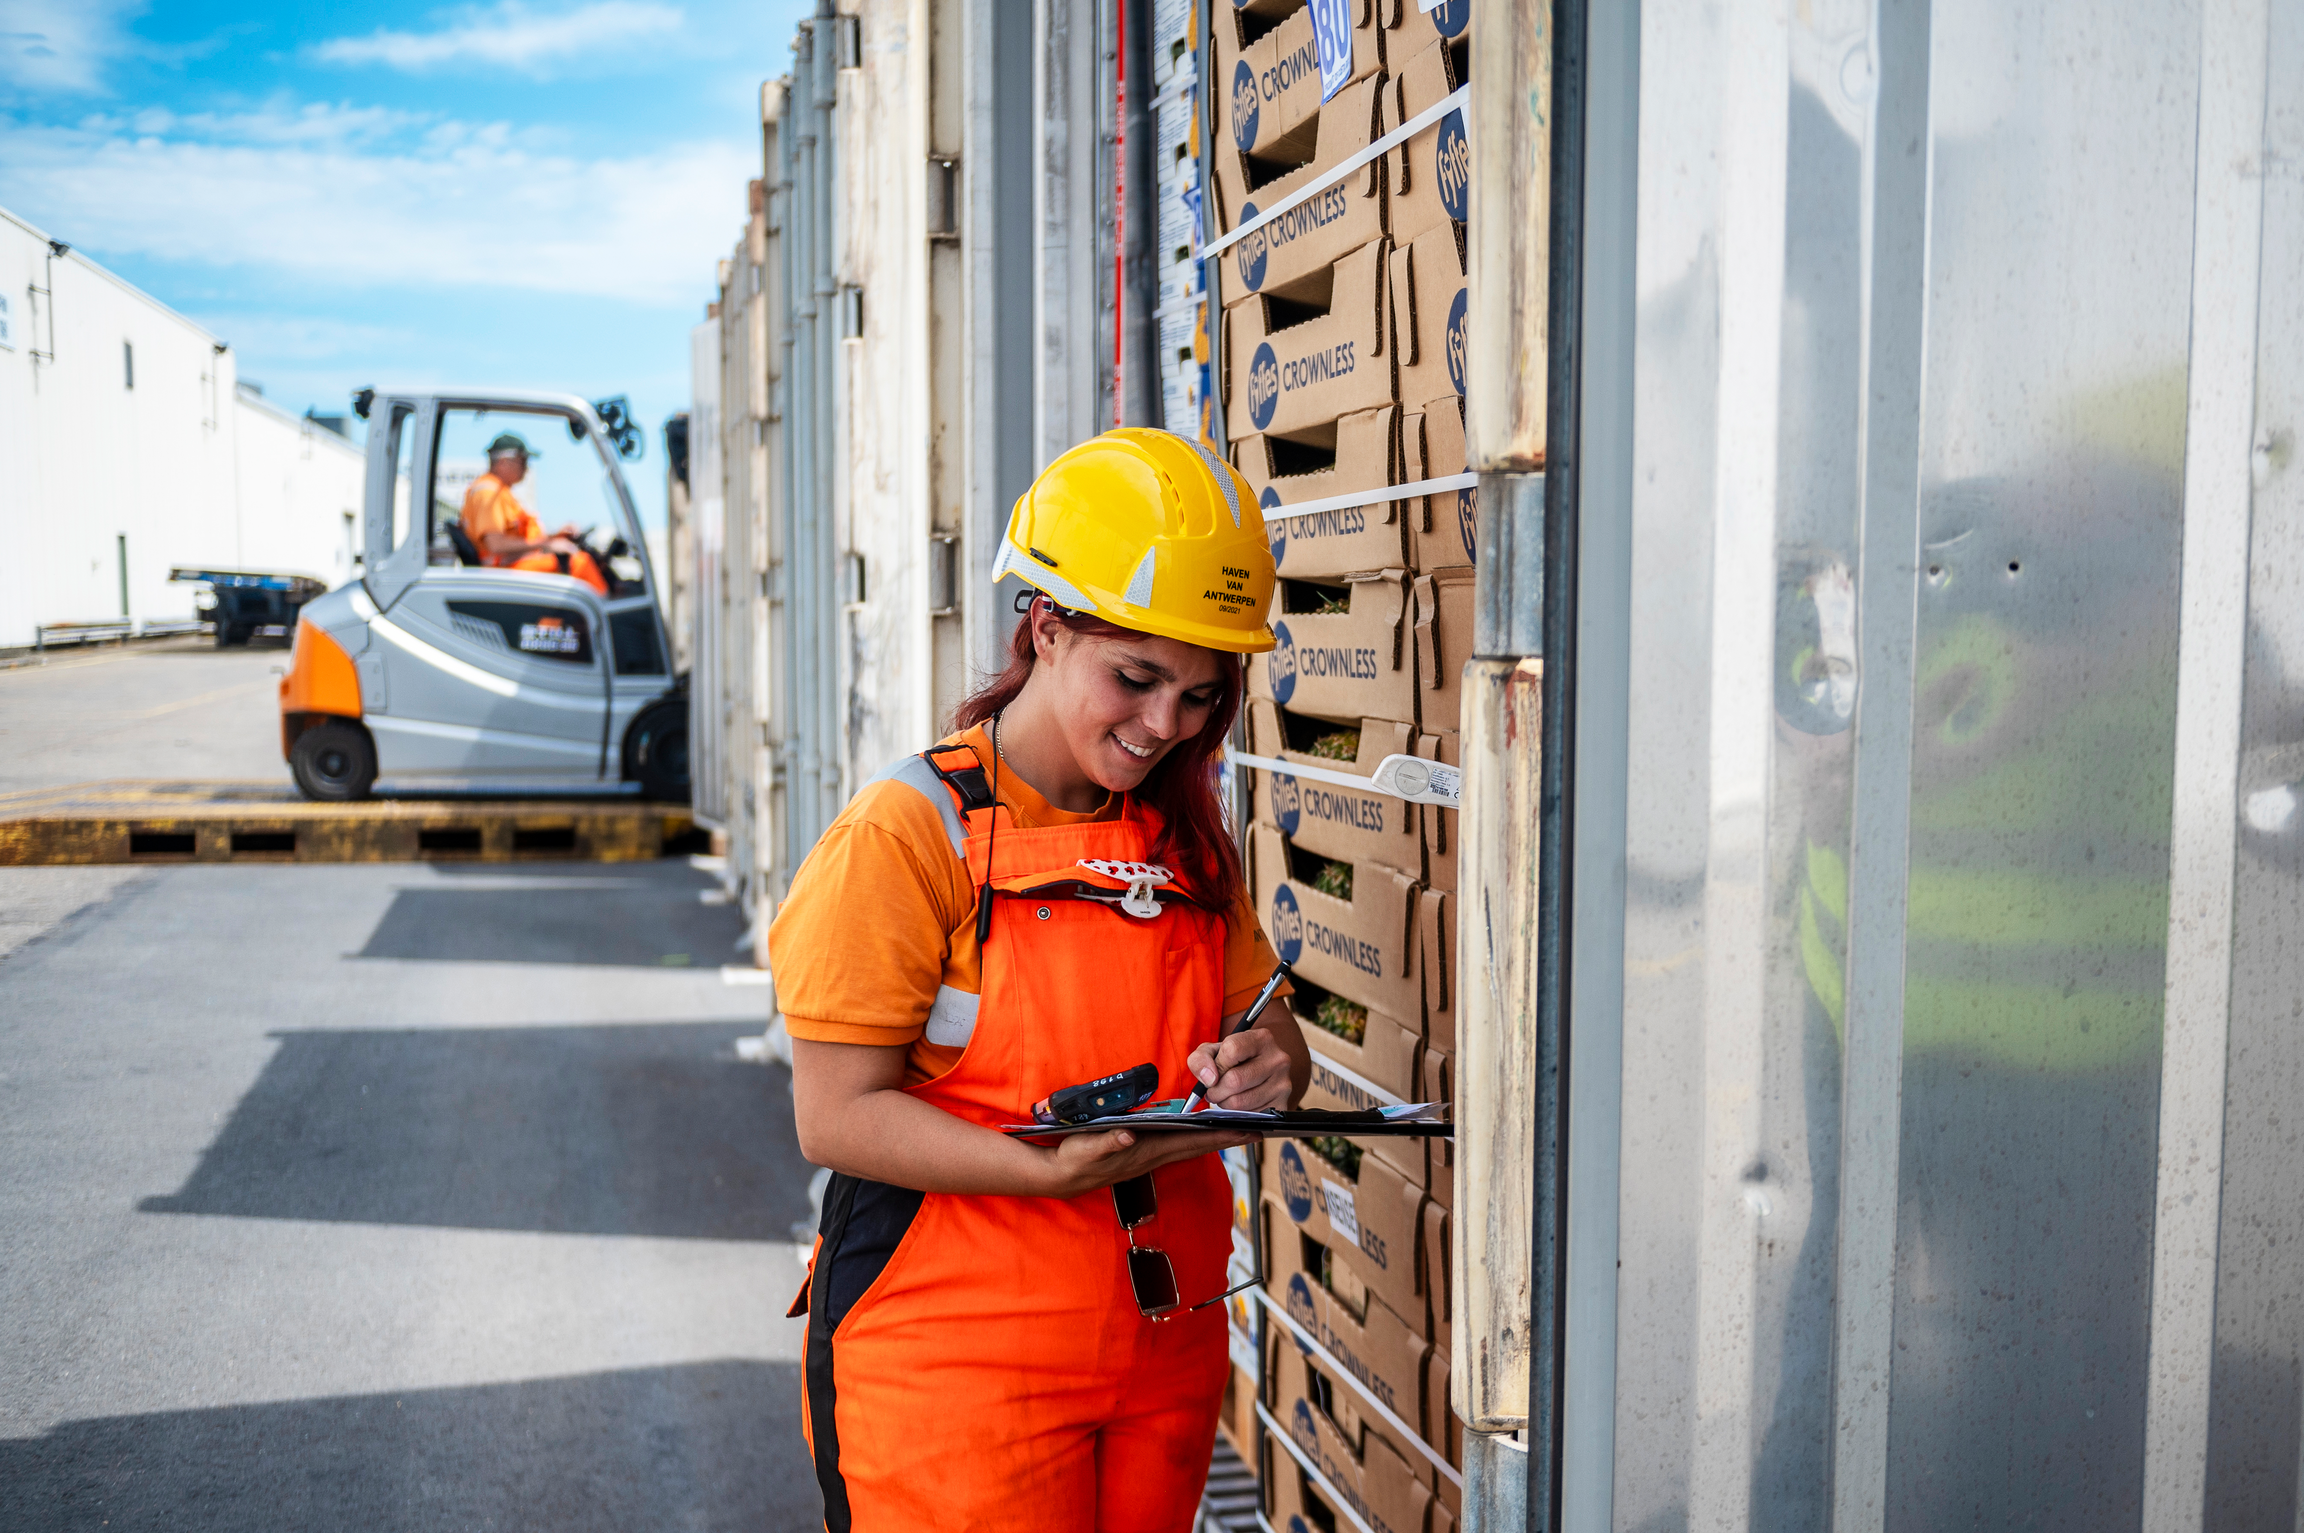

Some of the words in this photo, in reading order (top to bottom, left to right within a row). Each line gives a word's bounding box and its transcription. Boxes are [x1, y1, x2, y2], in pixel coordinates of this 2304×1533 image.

[1262, 38, 1318, 102] CROWNL
[1438, 130, 1469, 209] fyffe
[1270, 184, 1346, 248] CROWNLESS
[1250, 360, 1278, 419] fyffes
[1283, 341, 1355, 392] CROWNLESS
[1290, 505, 1365, 540] CROWNLESS
[1222, 566, 1250, 580] HAVEN
[1226, 580, 1243, 592] VAN
[1203, 590, 1257, 607] ANTWERPEN
[1218, 604, 1241, 615] 09/2021
[1300, 647, 1376, 680] CROWNLESS
[1304, 788, 1383, 833] CROWNLESS
[1306, 920, 1381, 978] CROWNLESS
